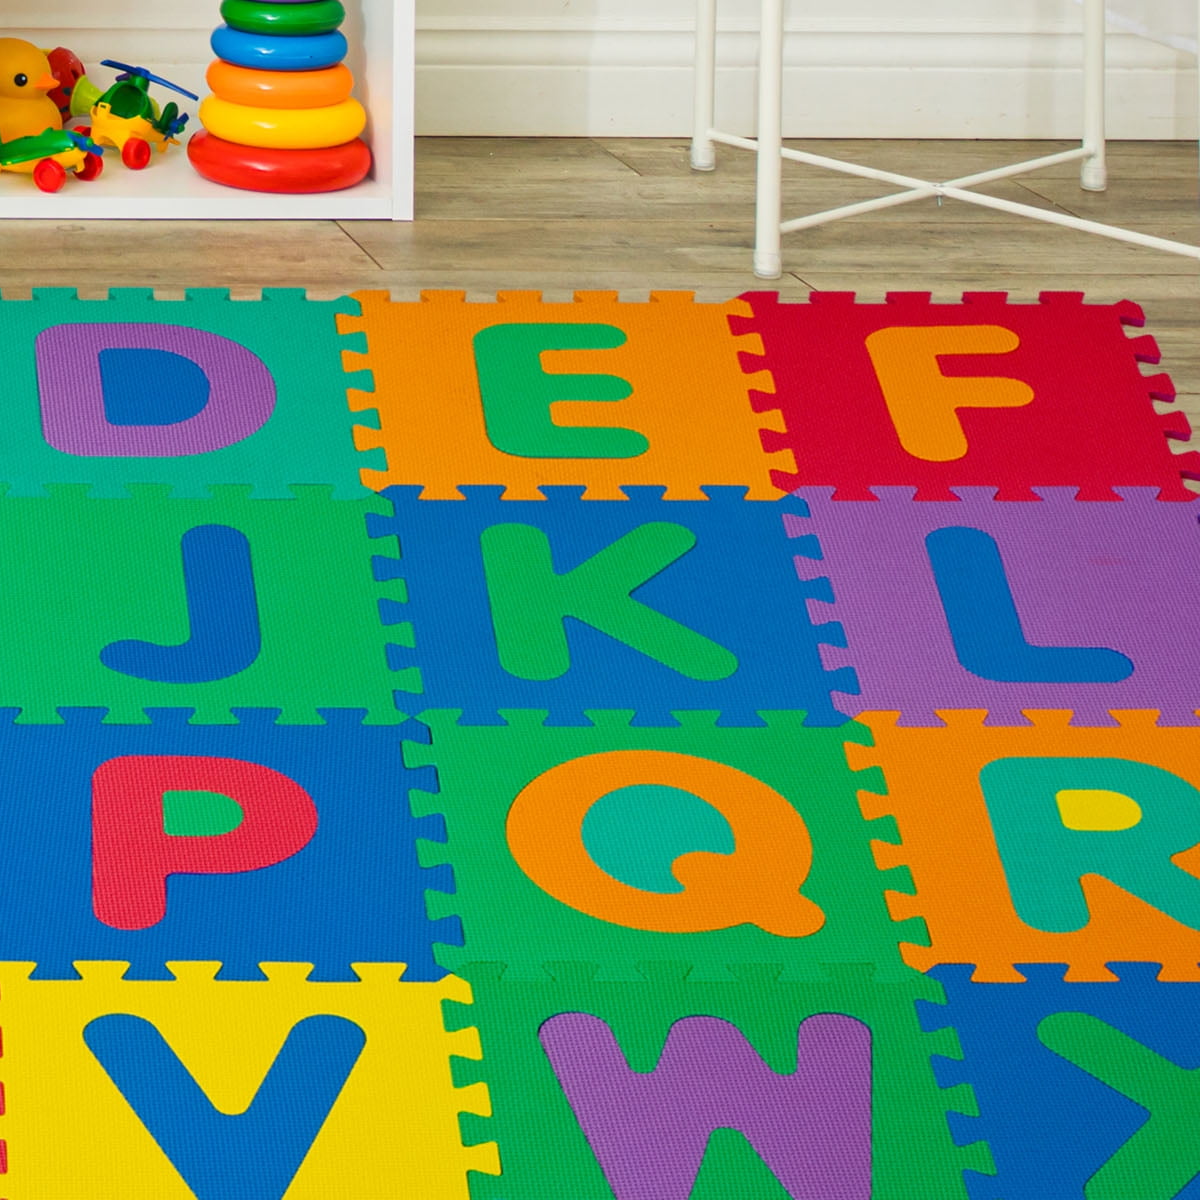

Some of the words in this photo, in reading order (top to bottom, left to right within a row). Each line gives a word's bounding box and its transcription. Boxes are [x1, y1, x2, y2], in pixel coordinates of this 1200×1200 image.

[35, 322, 278, 457] D
[473, 323, 649, 459] E
[866, 326, 1033, 461] F
[99, 523, 262, 684] J
[480, 522, 739, 681] K
[924, 525, 1135, 683] L
[92, 755, 319, 930] P
[505, 749, 826, 937] Q
[978, 756, 1200, 933] R
[83, 1013, 367, 1200] V
[537, 1011, 873, 1200] W
